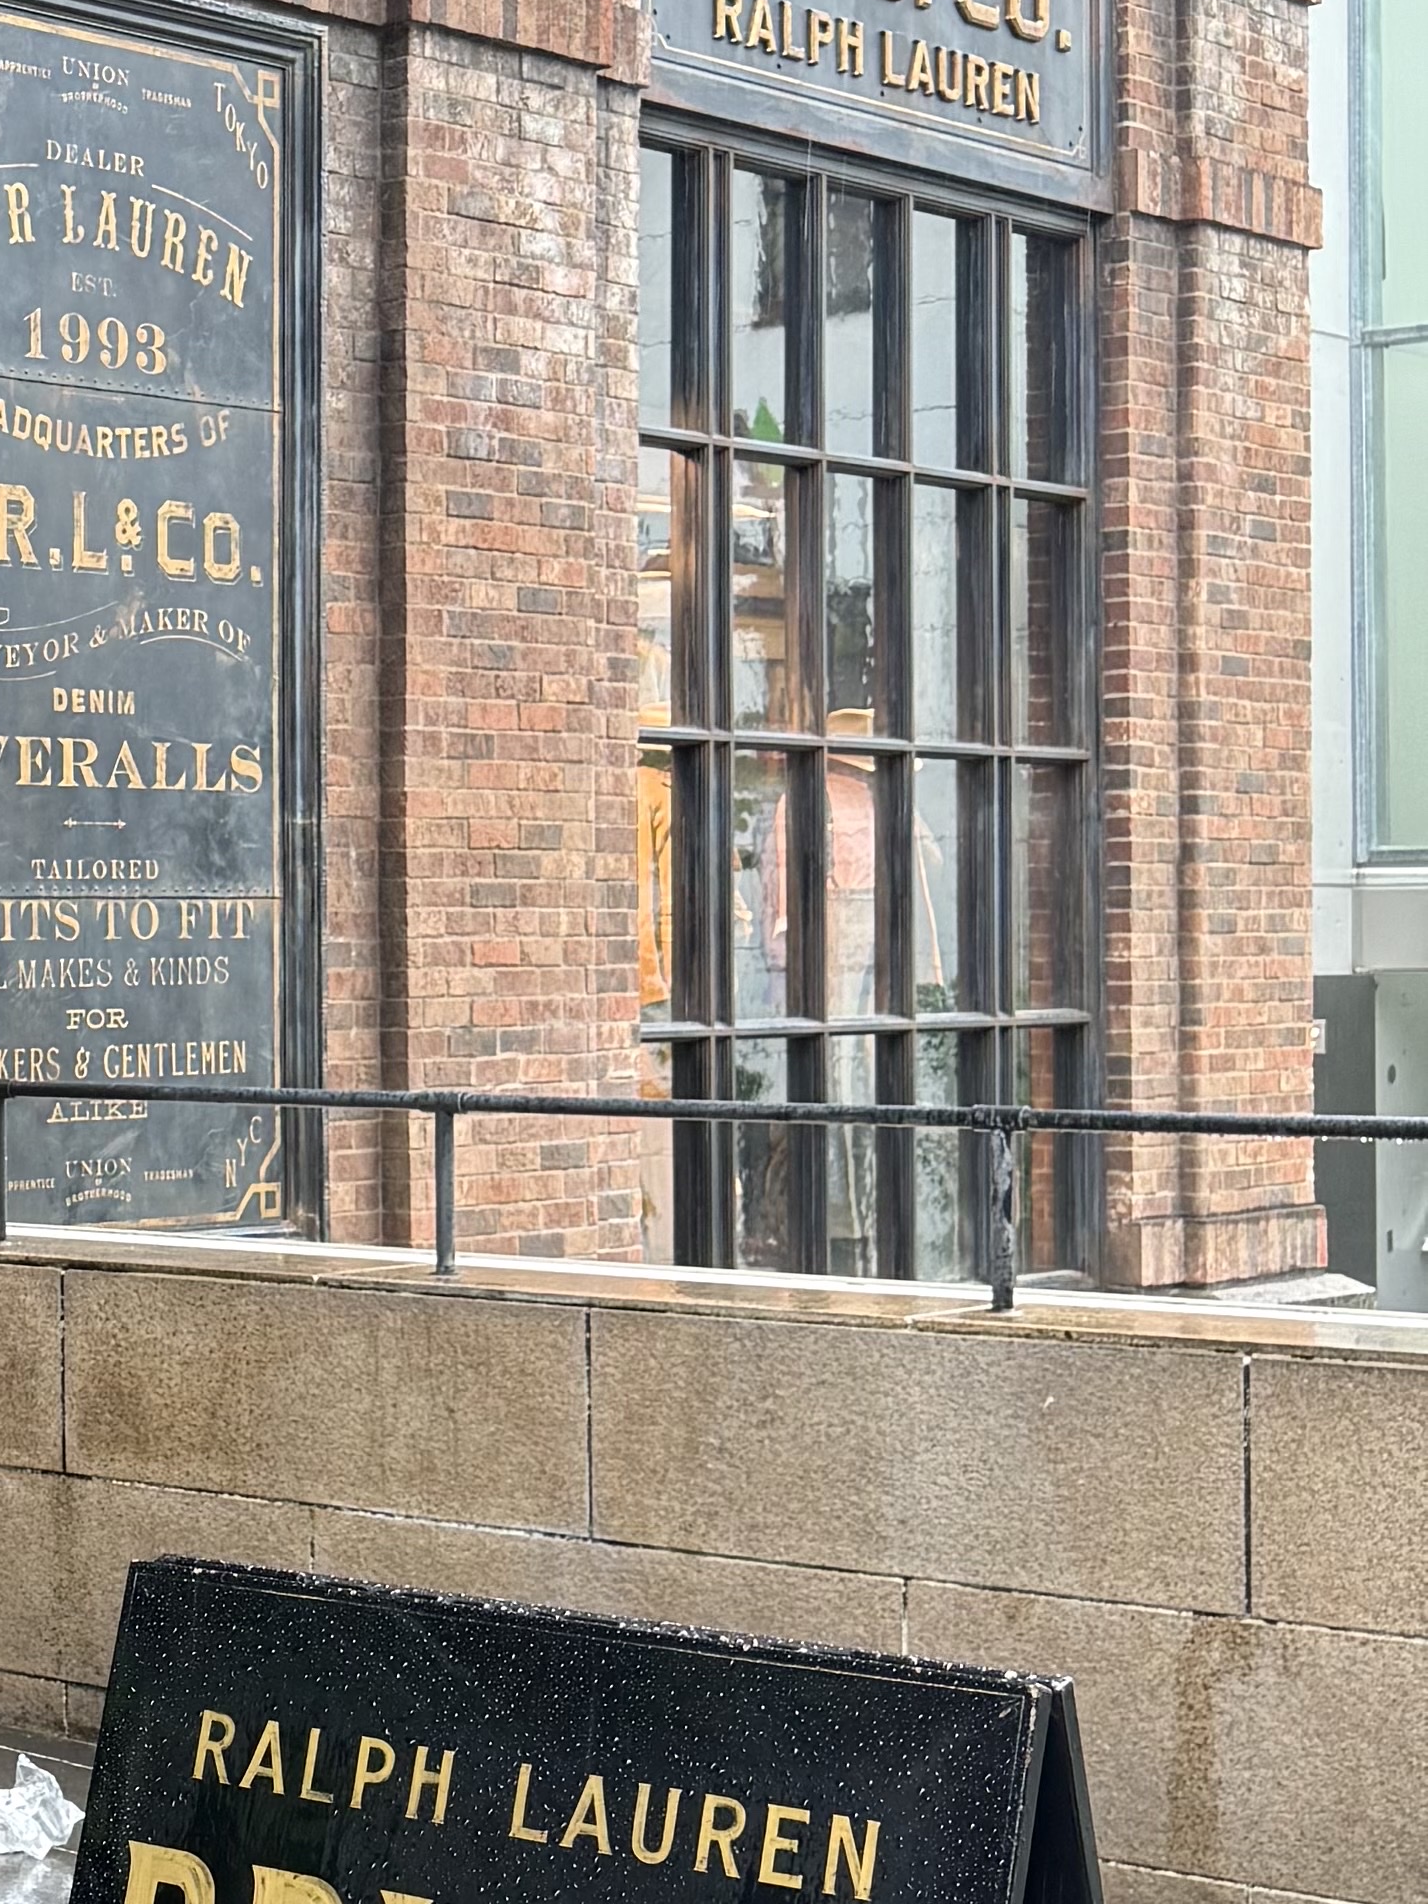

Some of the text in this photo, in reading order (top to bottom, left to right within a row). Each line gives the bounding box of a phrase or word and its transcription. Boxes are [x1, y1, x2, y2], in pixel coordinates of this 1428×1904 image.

[61, 55, 130, 86] UNION
[881, 30, 1041, 125] LAUREN
[213, 82, 268, 190] TOKYO
[45, 138, 145, 178] DEALER
[62, 184, 253, 310] LAUREN
[71, 272, 117, 297] EST.
[23, 307, 169, 375] 1993
[199, 407, 233, 447] OF
[88, 624, 108, 648] &
[117, 607, 209, 640] MAKER
[218, 619, 252, 654] OF
[52, 687, 136, 715] DENIM
[30, 858, 159, 881] TAILORED
[96, 899, 160, 942] TO
[178, 899, 256, 942] FIT
[16, 956, 114, 990] MAKES
[124, 959, 141, 988] &
[149, 955, 230, 987] KINDS
[65, 1007, 129, 1031] FOR
[74, 1046, 91, 1079] &
[104, 1040, 247, 1079] GENTLEMEN
[47, 1099, 148, 1123] ALIKE
[65, 1157, 132, 1179] UNION
[224, 1115, 263, 1189] NYC
[8, 1178, 55, 1191] PPRENTICE
[192, 1708, 882, 1903] RALPH LAUREN
